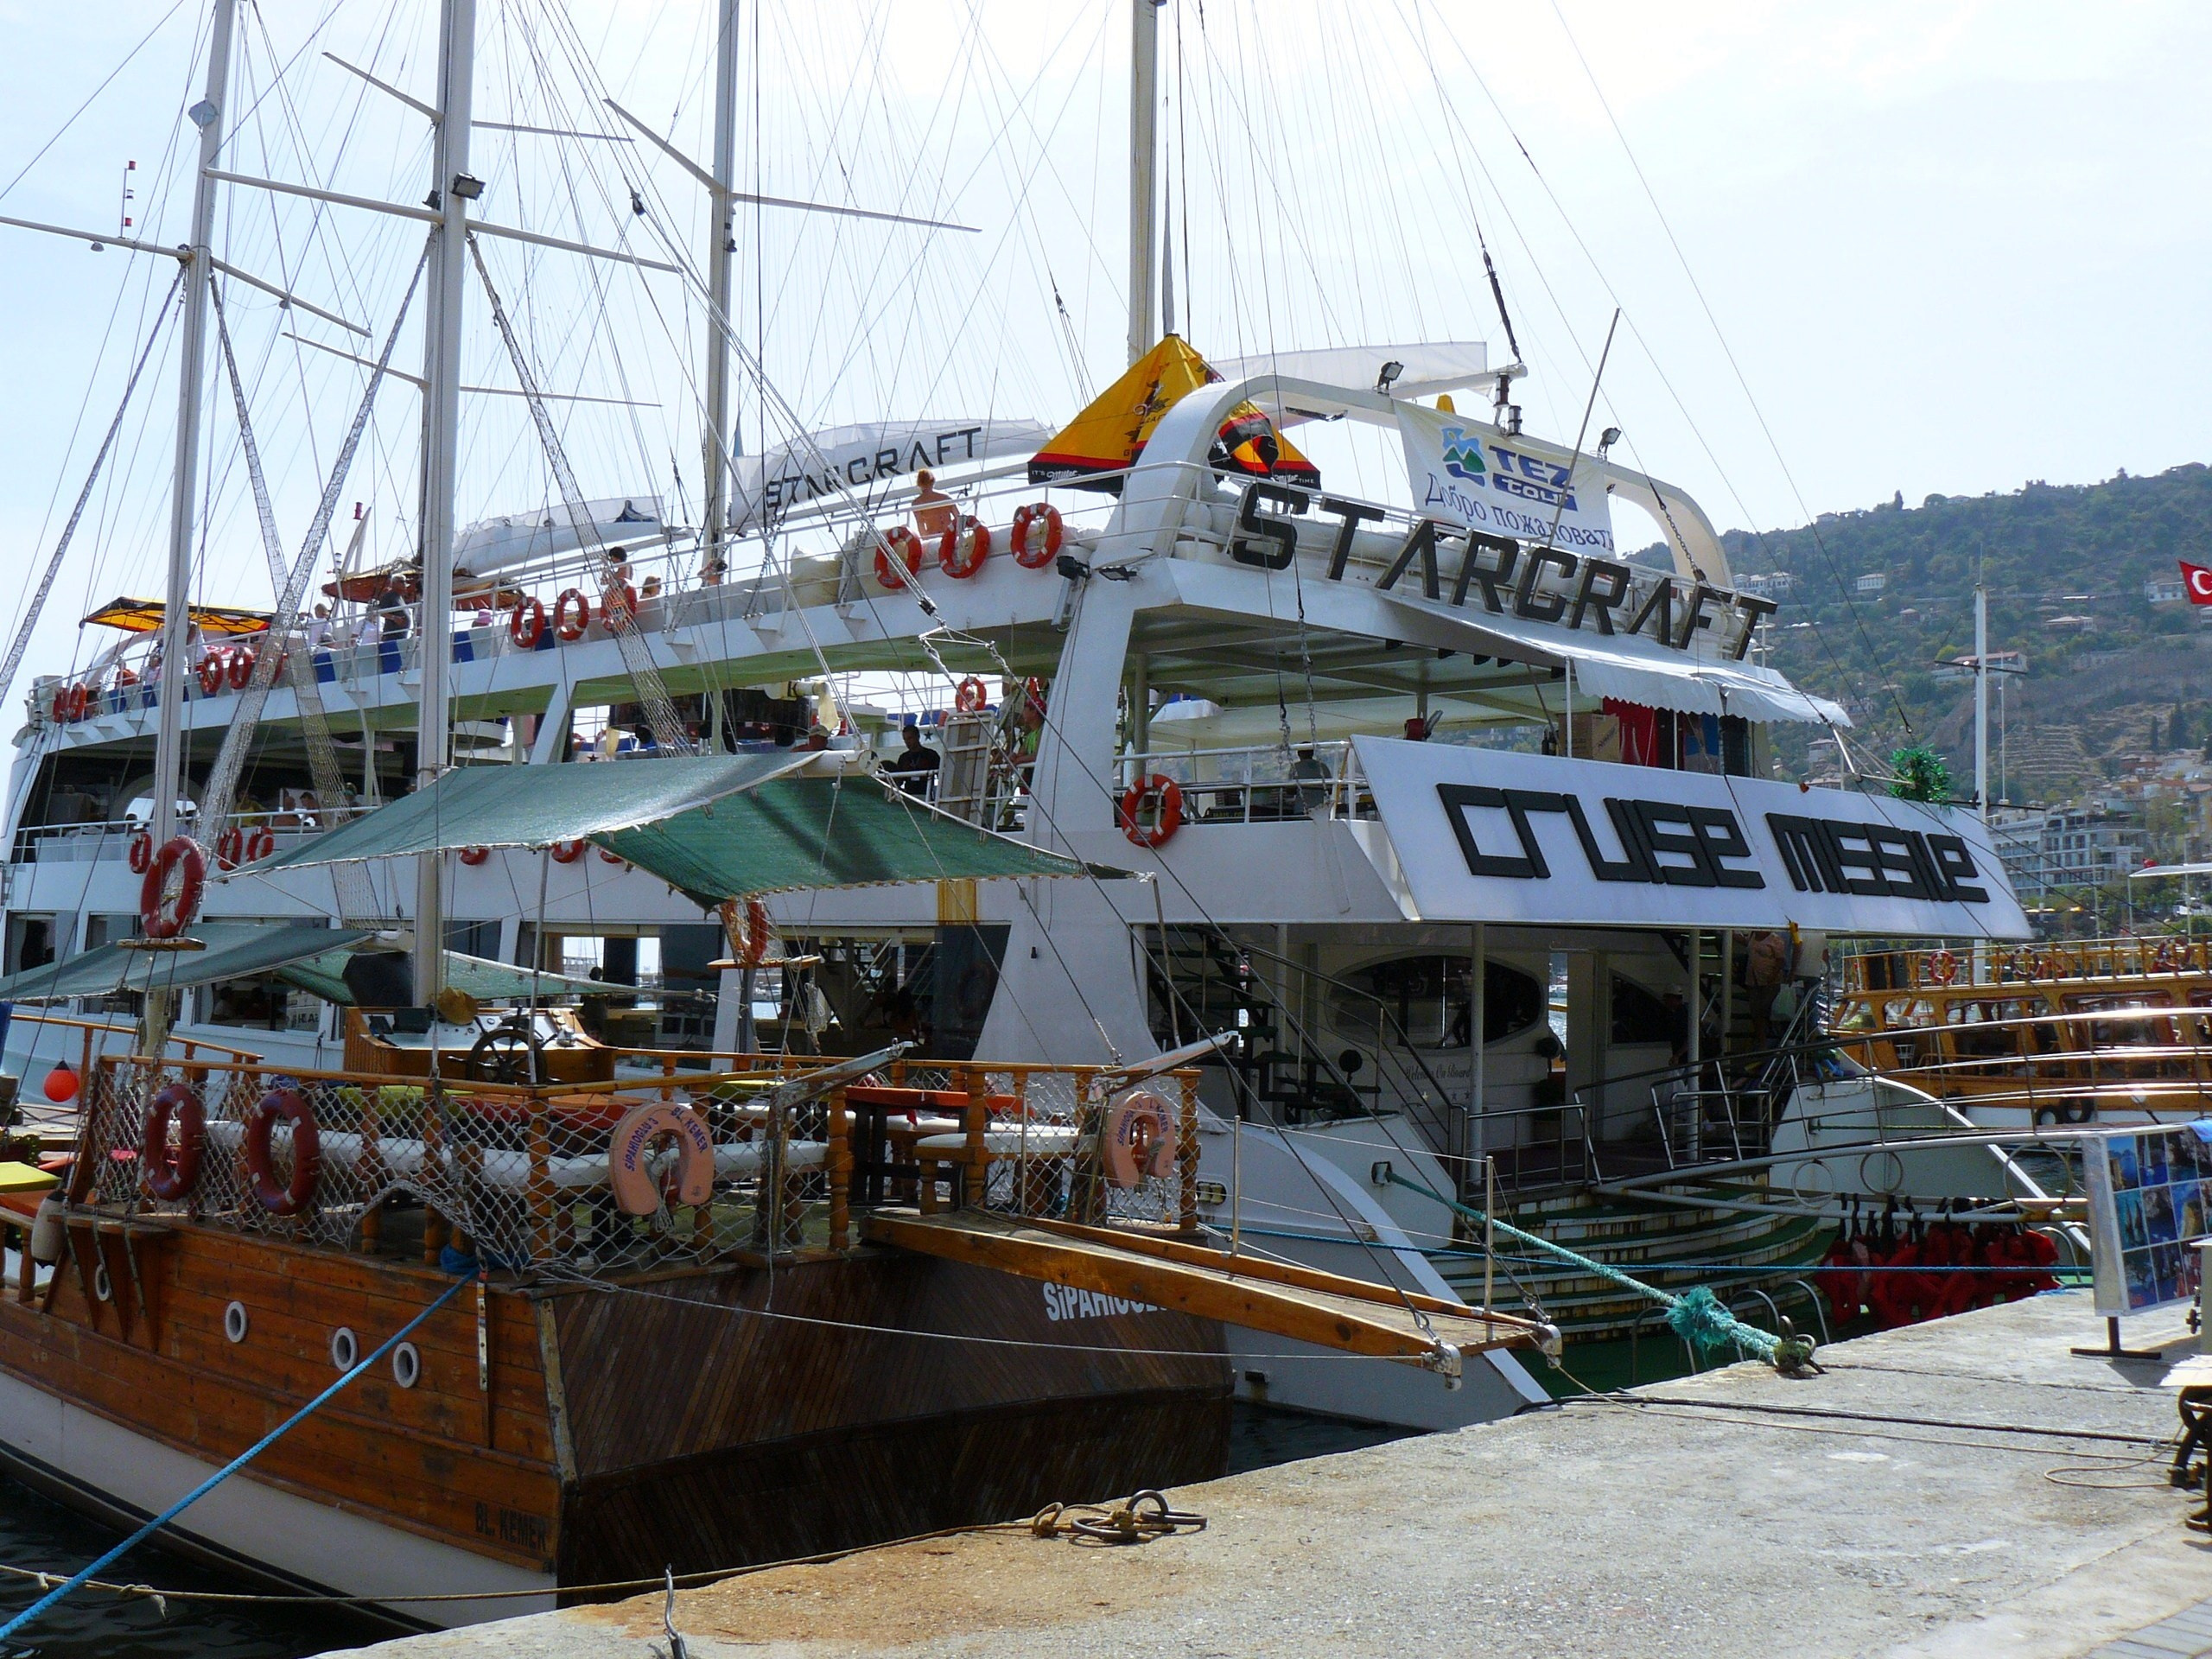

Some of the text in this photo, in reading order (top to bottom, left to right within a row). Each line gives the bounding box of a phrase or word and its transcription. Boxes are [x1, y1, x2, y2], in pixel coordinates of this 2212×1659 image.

[766, 426, 982, 508] STARCRAFT
[1488, 444, 1575, 492] TEZ
[1425, 472, 1487, 522] Добро
[1231, 482, 1778, 661] STARCRAFT
[684, 1117, 709, 1154] KEMER
